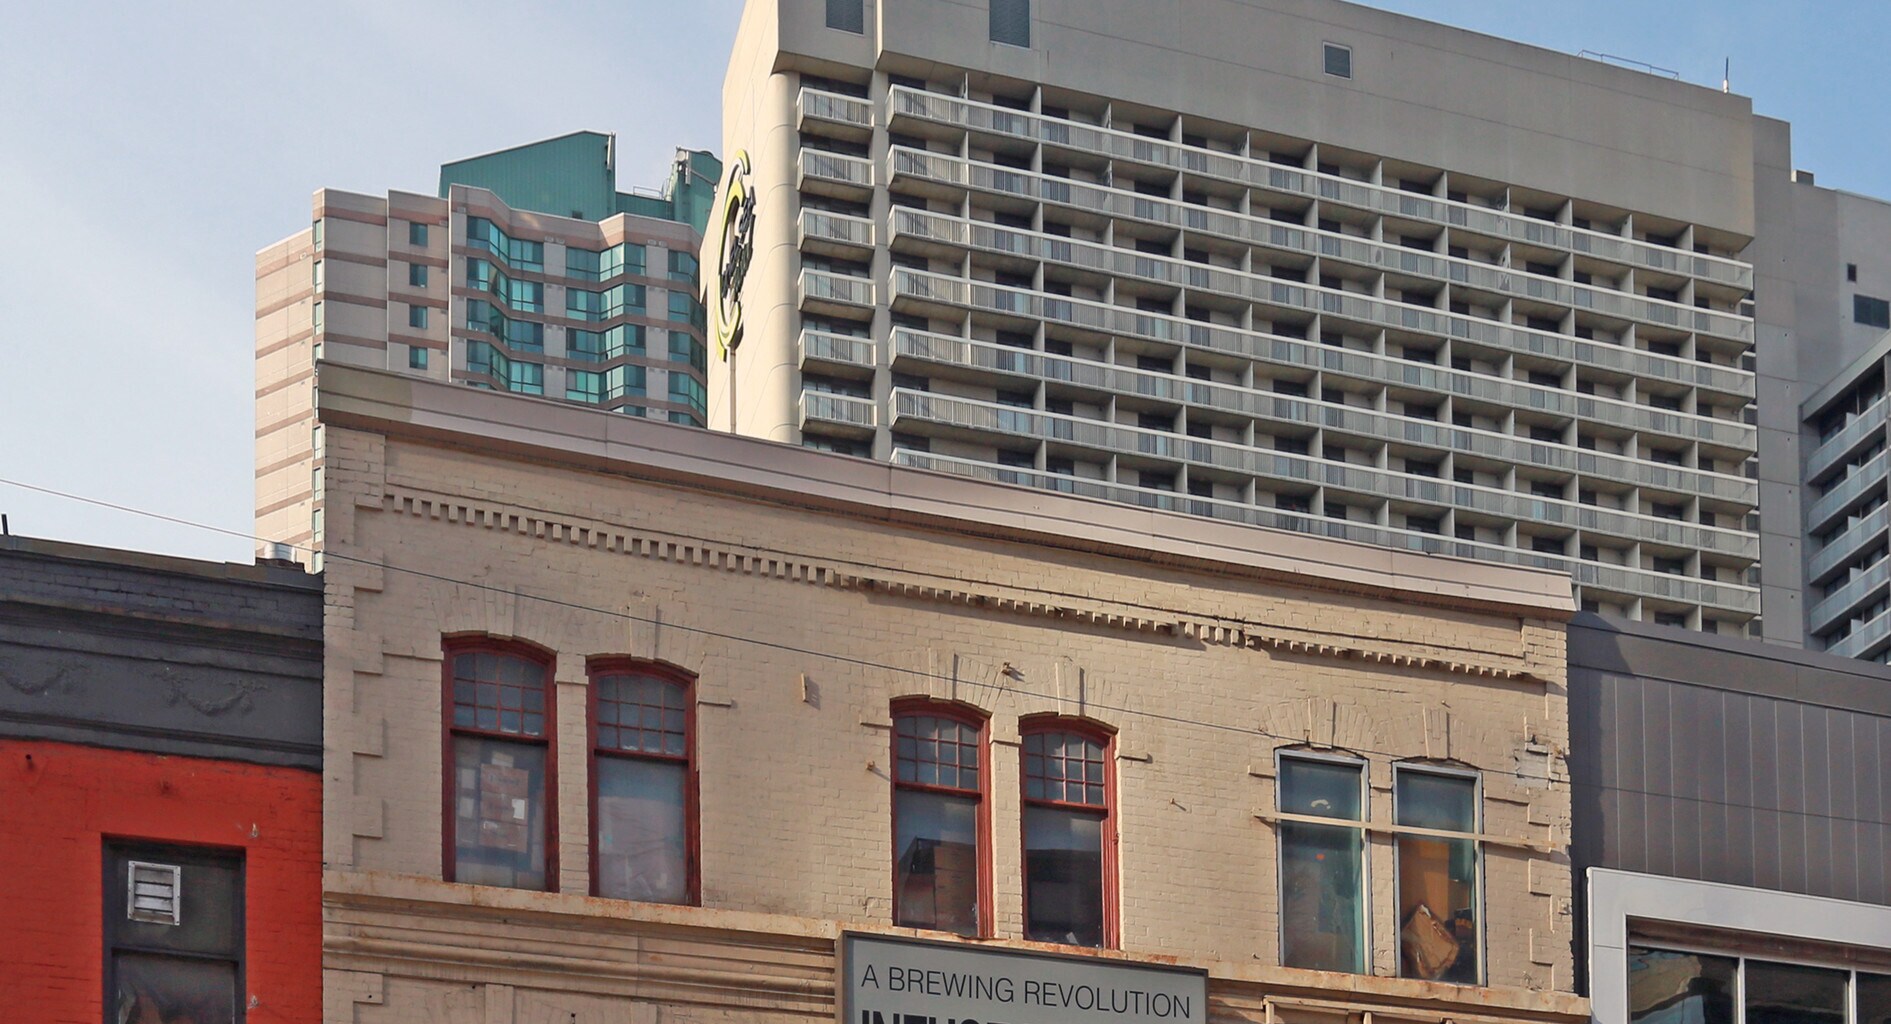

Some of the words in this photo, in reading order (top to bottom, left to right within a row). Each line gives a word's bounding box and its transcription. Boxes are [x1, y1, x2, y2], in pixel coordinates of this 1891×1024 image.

[861, 964, 879, 988] A
[889, 966, 1014, 1003] BREWING
[1024, 980, 1191, 1019] REVOLUTION
